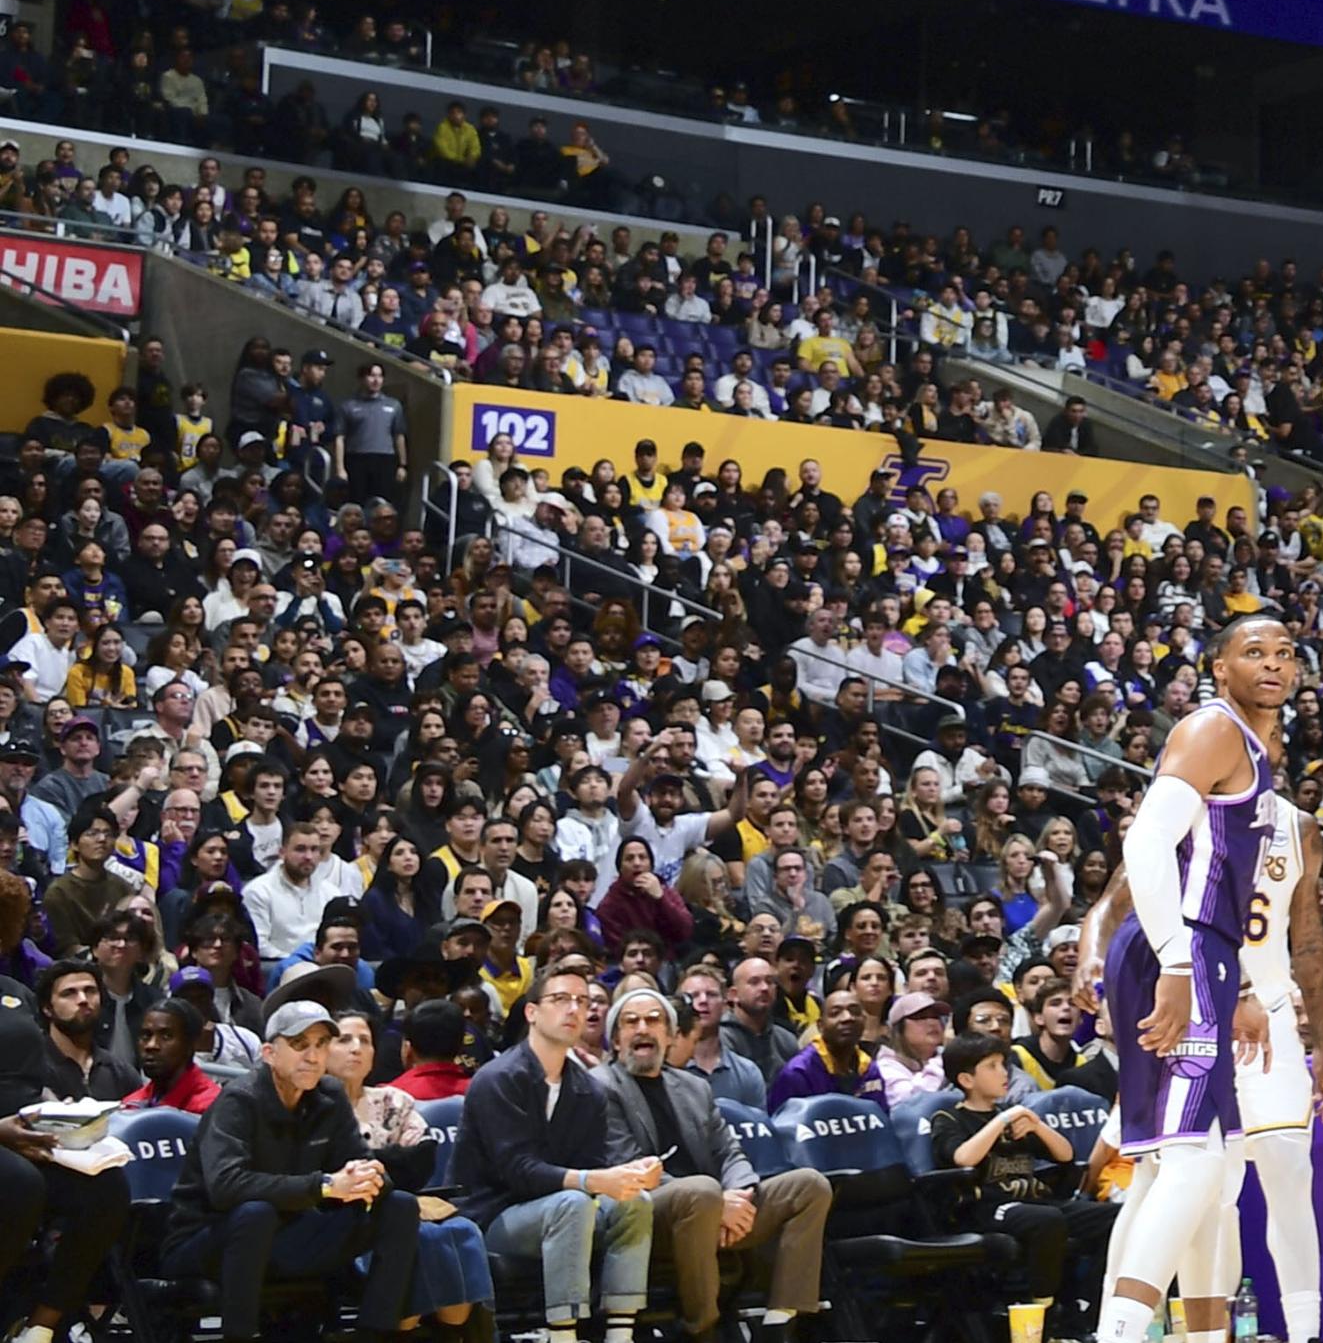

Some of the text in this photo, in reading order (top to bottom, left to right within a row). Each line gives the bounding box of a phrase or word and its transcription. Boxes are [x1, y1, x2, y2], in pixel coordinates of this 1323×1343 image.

[480, 408, 552, 452] 102
[816, 1113, 885, 1136] DELTA
[1045, 1107, 1110, 1130] DELTA
